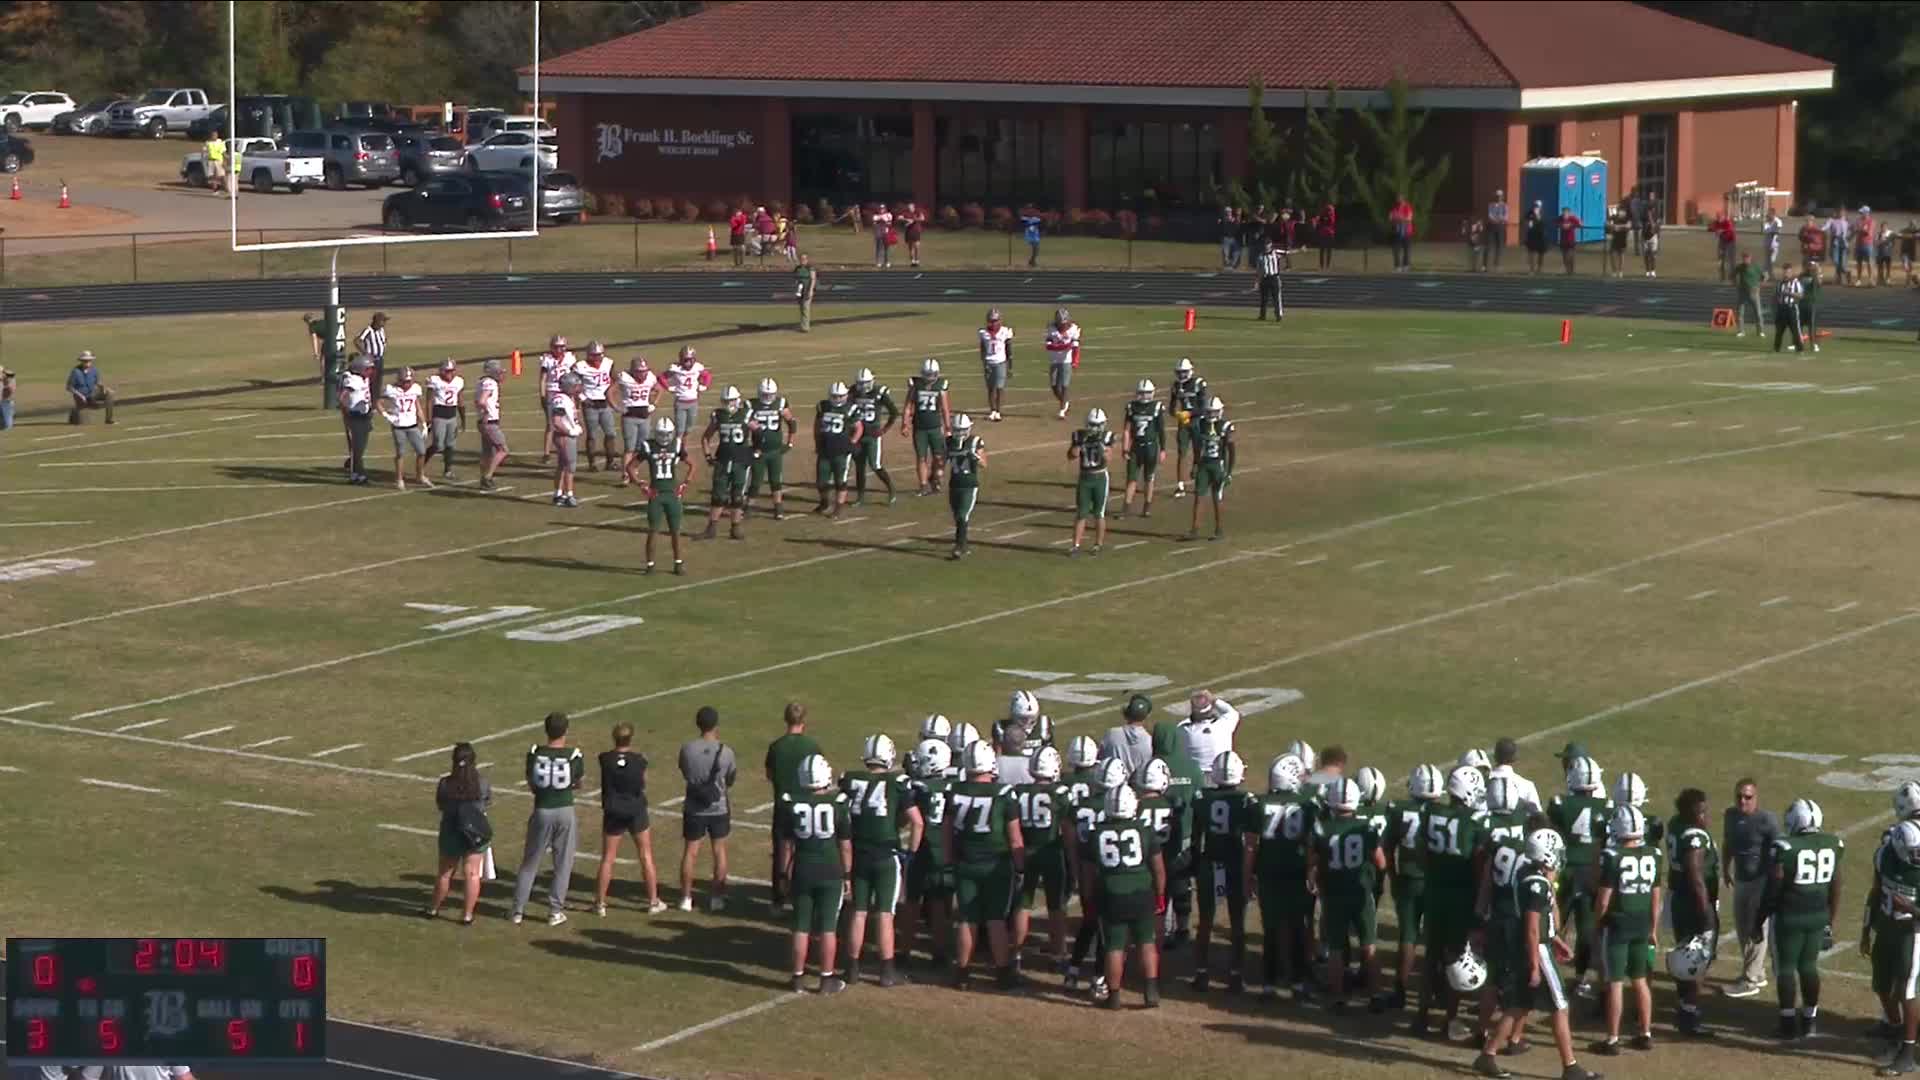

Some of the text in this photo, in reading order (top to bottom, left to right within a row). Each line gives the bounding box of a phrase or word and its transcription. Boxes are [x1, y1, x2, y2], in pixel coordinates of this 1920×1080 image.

[624, 128, 661, 144] Frank
[737, 131, 755, 145] Sr.
[656, 459, 673, 479] 11
[850, 778, 888, 817] 74
[952, 794, 993, 834] 77
[1018, 792, 1051, 828] 16
[793, 802, 835, 839] 30
[1210, 801, 1231, 835] 9
[1427, 815, 1462, 856] 51
[1099, 828, 1143, 868] 63
[1328, 833, 1364, 870] 18
[1795, 848, 1836, 885] 68
[1619, 855, 1656, 894] 29
[34, 955, 315, 988] 0 0
[134, 939, 222, 969] 2:04
[27, 1018, 46, 1051] 3
[98, 1018, 121, 1051] 5
[228, 1018, 249, 1051] 5
